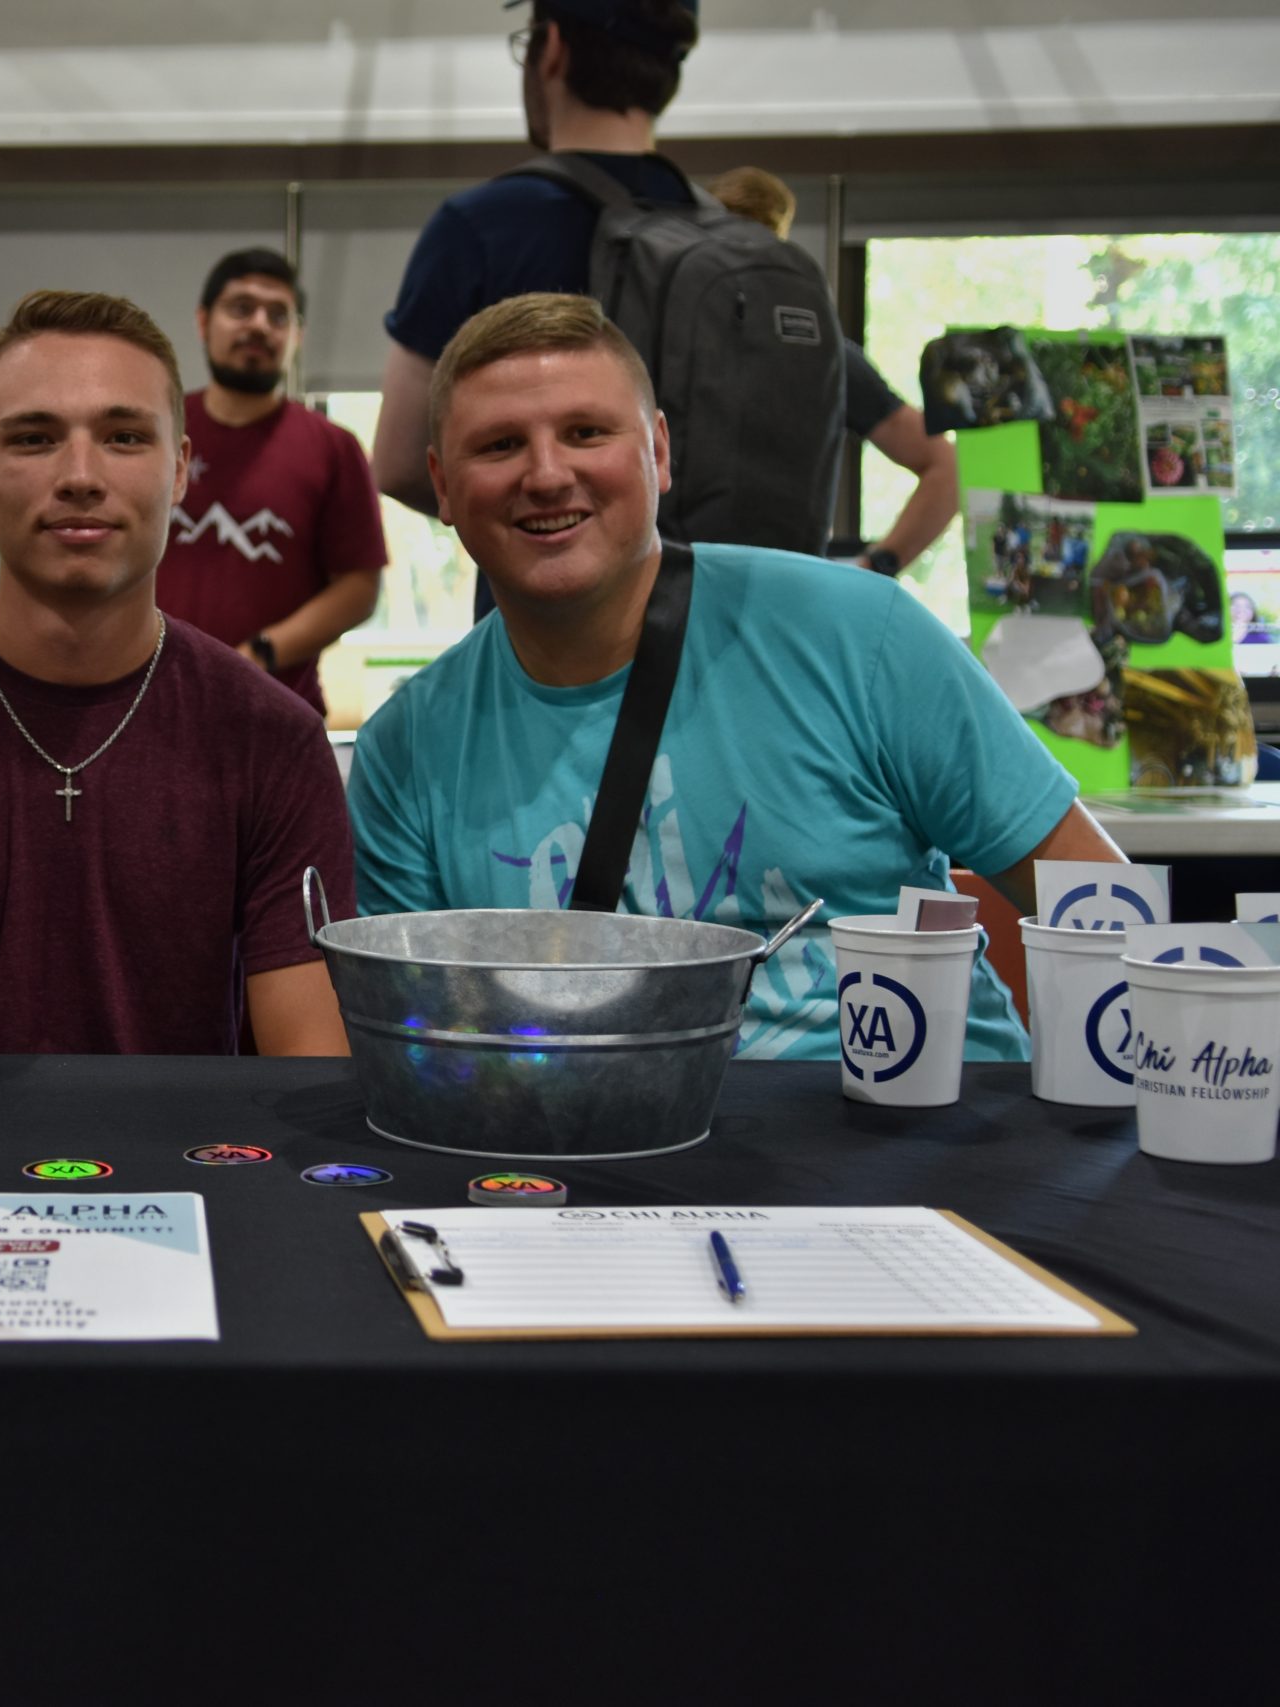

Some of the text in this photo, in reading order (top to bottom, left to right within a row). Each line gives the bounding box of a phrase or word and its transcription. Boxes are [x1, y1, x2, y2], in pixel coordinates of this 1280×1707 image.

[847, 1001, 896, 1052] XA
[1135, 1030, 1273, 1087] Chi Alpha
[1136, 1077, 1270, 1100] CHRISTIAN FELLOWSHIP
[11, 1203, 167, 1217] ALPHA
